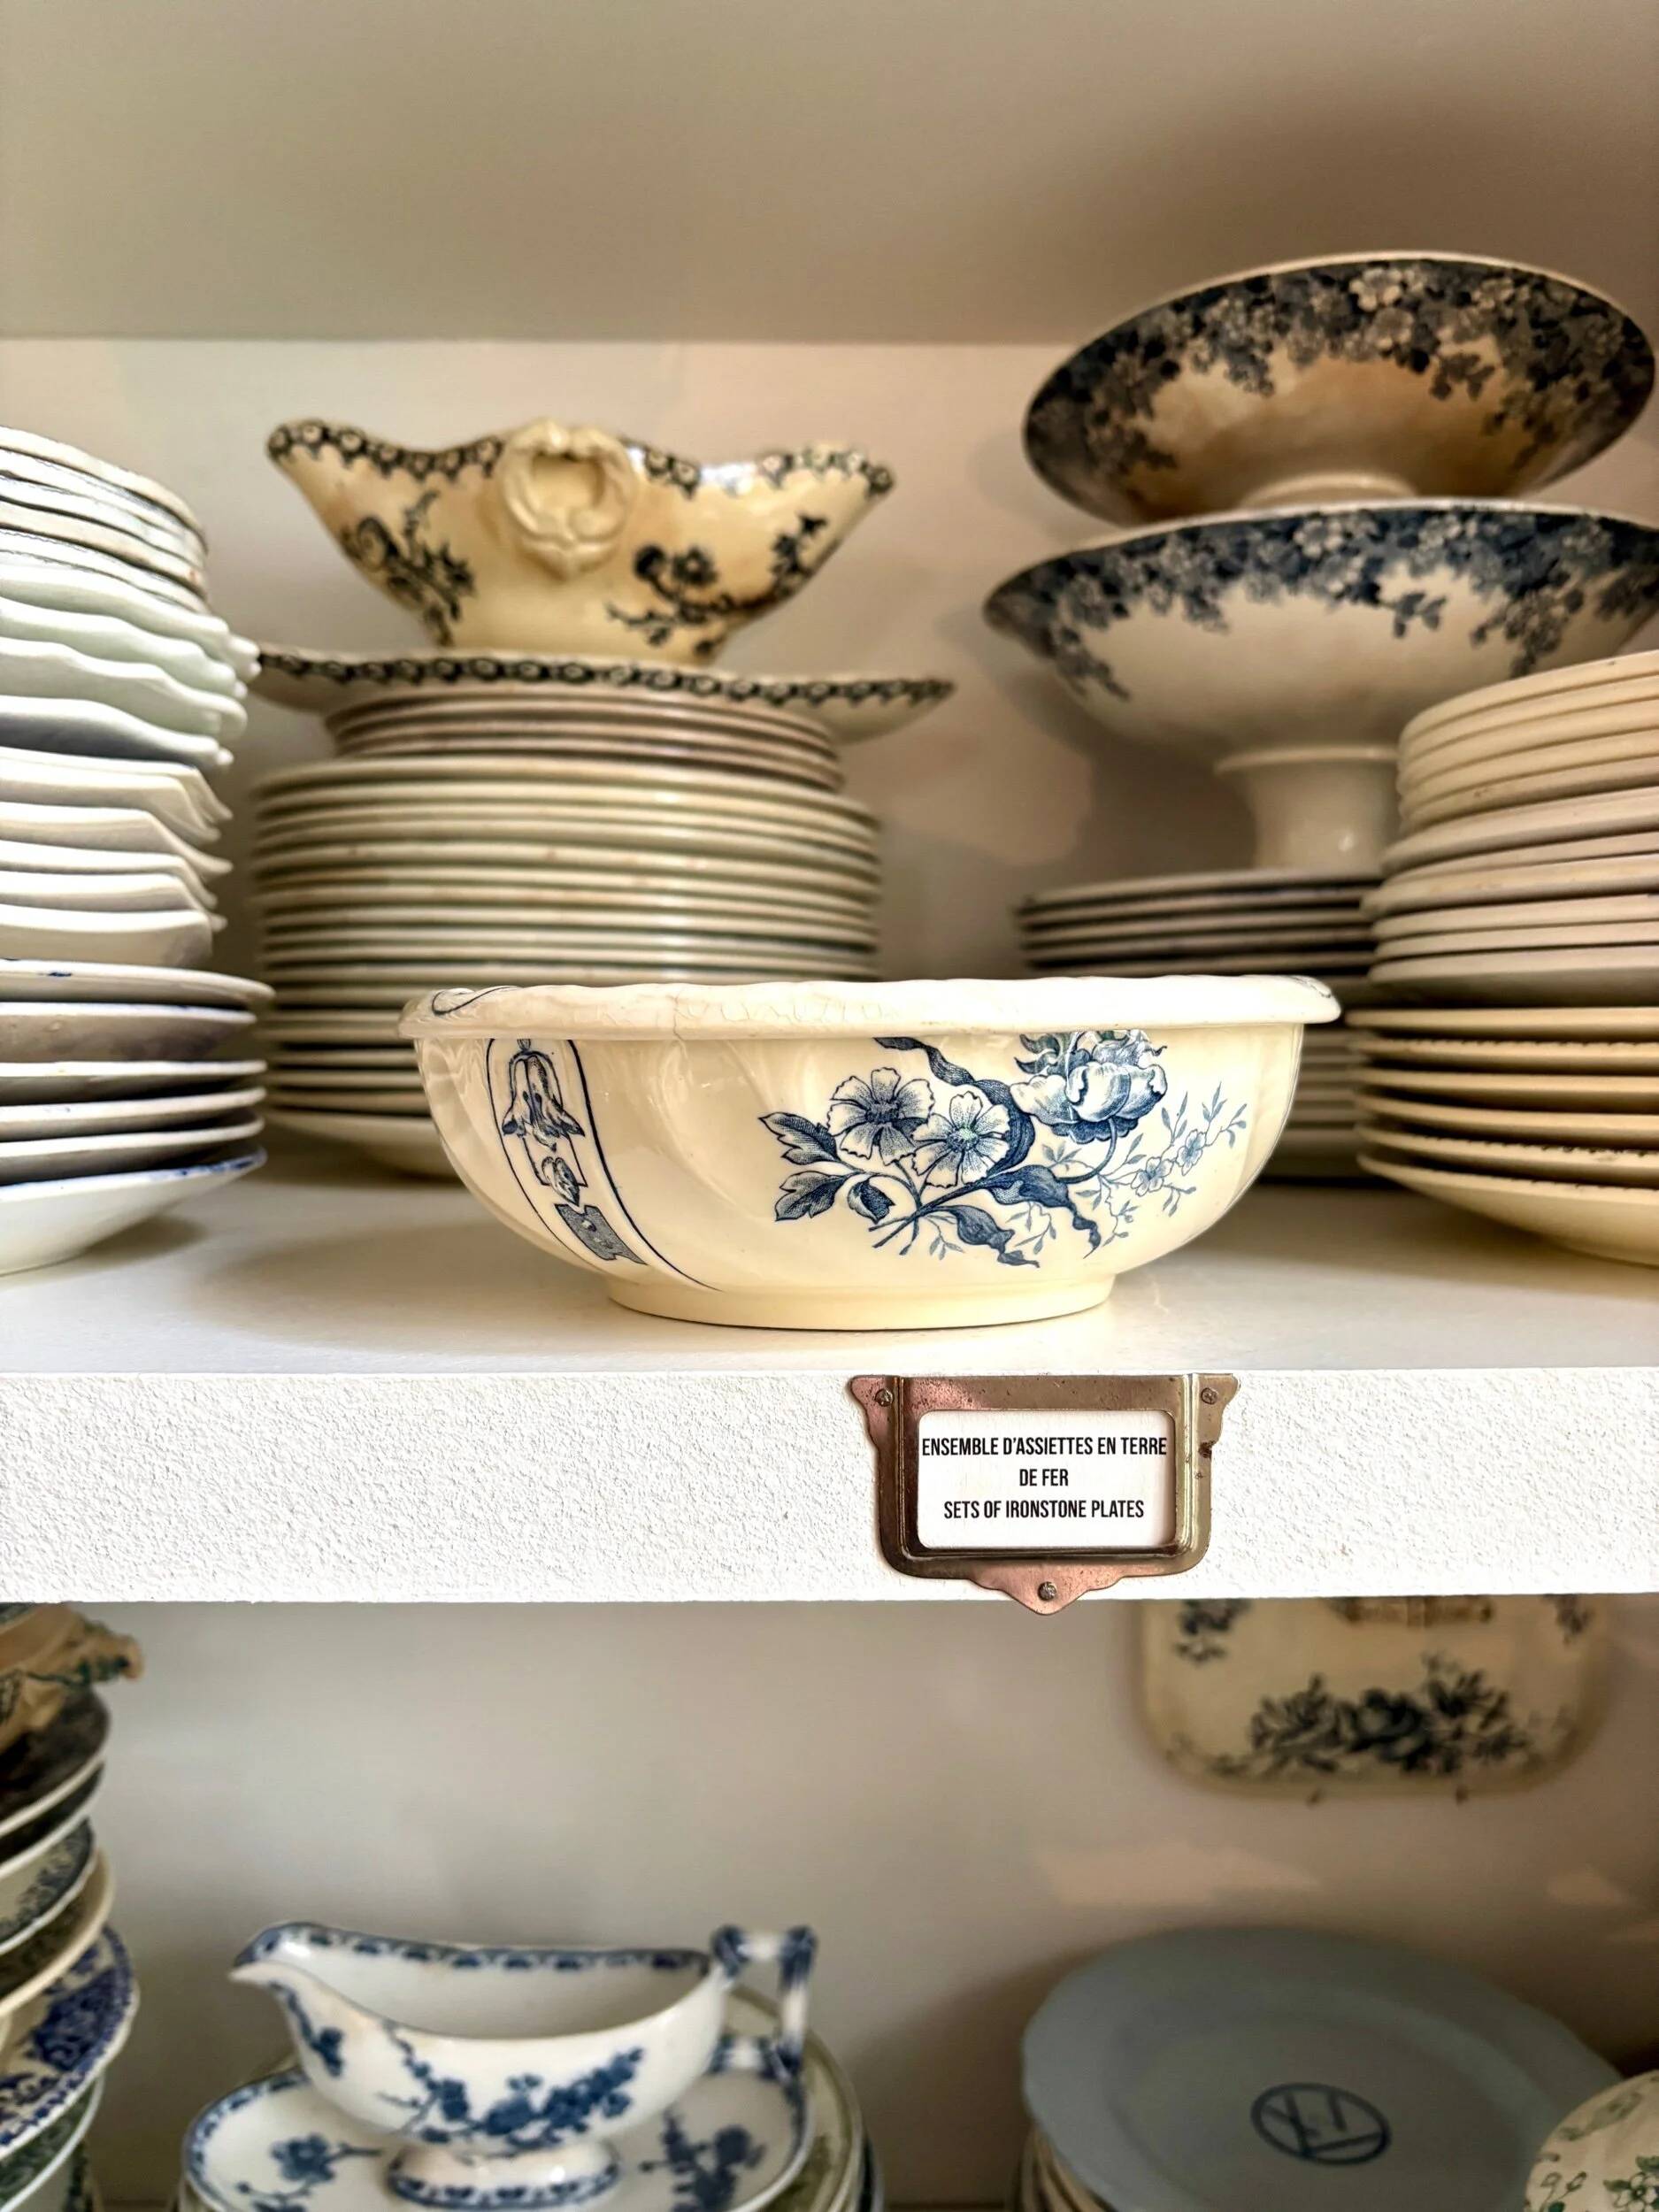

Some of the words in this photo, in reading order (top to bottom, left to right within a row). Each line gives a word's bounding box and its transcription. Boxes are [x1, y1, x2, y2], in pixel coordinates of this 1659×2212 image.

[922, 1437, 999, 1456] ENSEMBLE
[1002, 1436, 1094, 1455] D'ASSIETTES
[1097, 1437, 1117, 1455] EN
[1120, 1437, 1168, 1455] TERRE
[1019, 1468, 1038, 1486] DE
[1041, 1468, 1069, 1486] FER
[944, 1500, 979, 1519] SETS
[983, 1500, 1002, 1518] OF
[1005, 1500, 1087, 1518] IRONSTONE
[1091, 1500, 1144, 1518] PLATES
